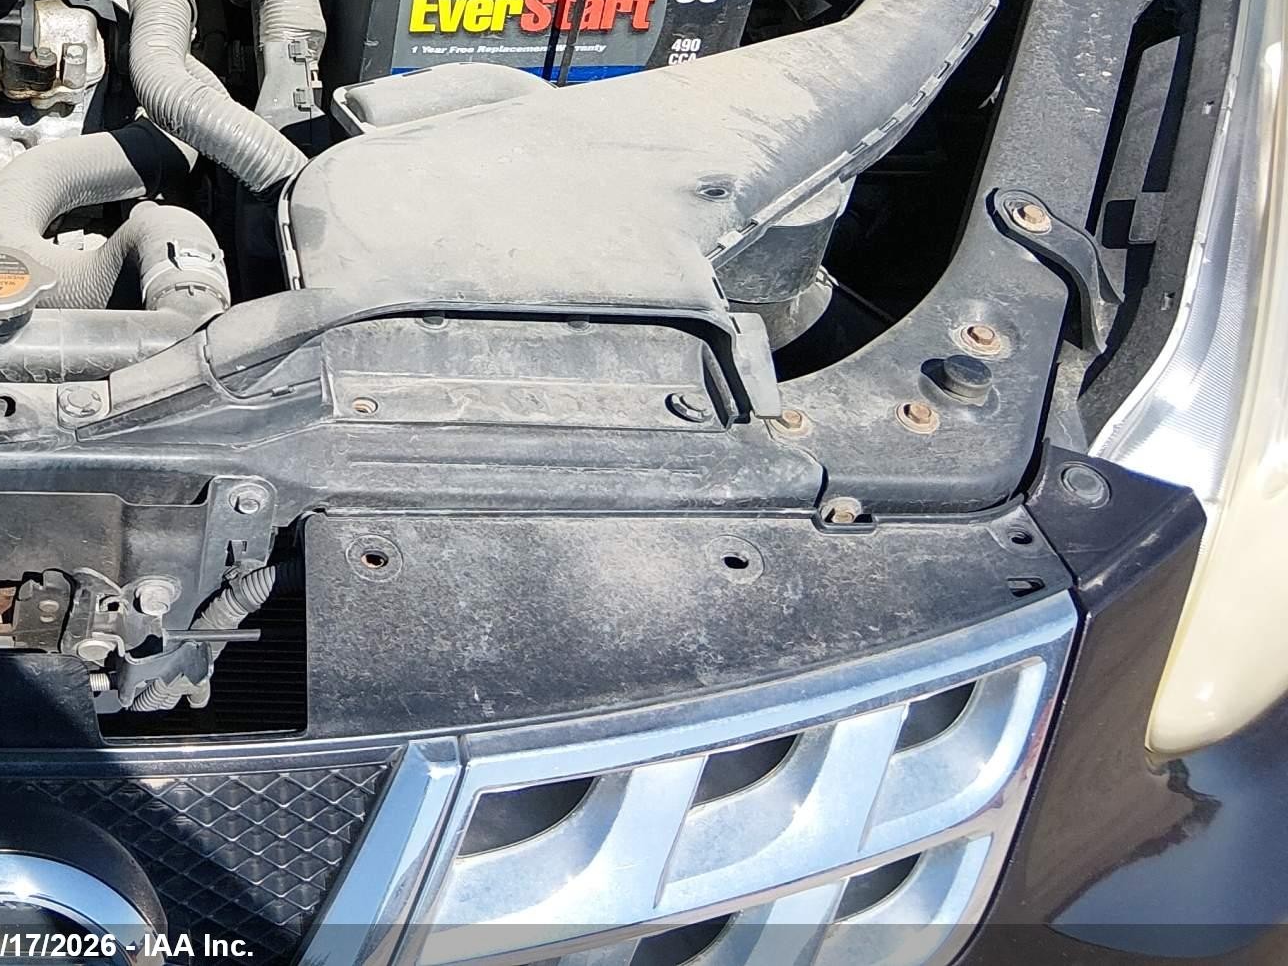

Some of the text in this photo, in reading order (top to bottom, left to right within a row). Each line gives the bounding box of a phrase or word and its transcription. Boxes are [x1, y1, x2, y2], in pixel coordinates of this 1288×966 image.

[412, 45, 418, 54] 1
[421, 45, 448, 54] Year
[449, 45, 475, 54] Free
[671, 38, 702, 52] 490
